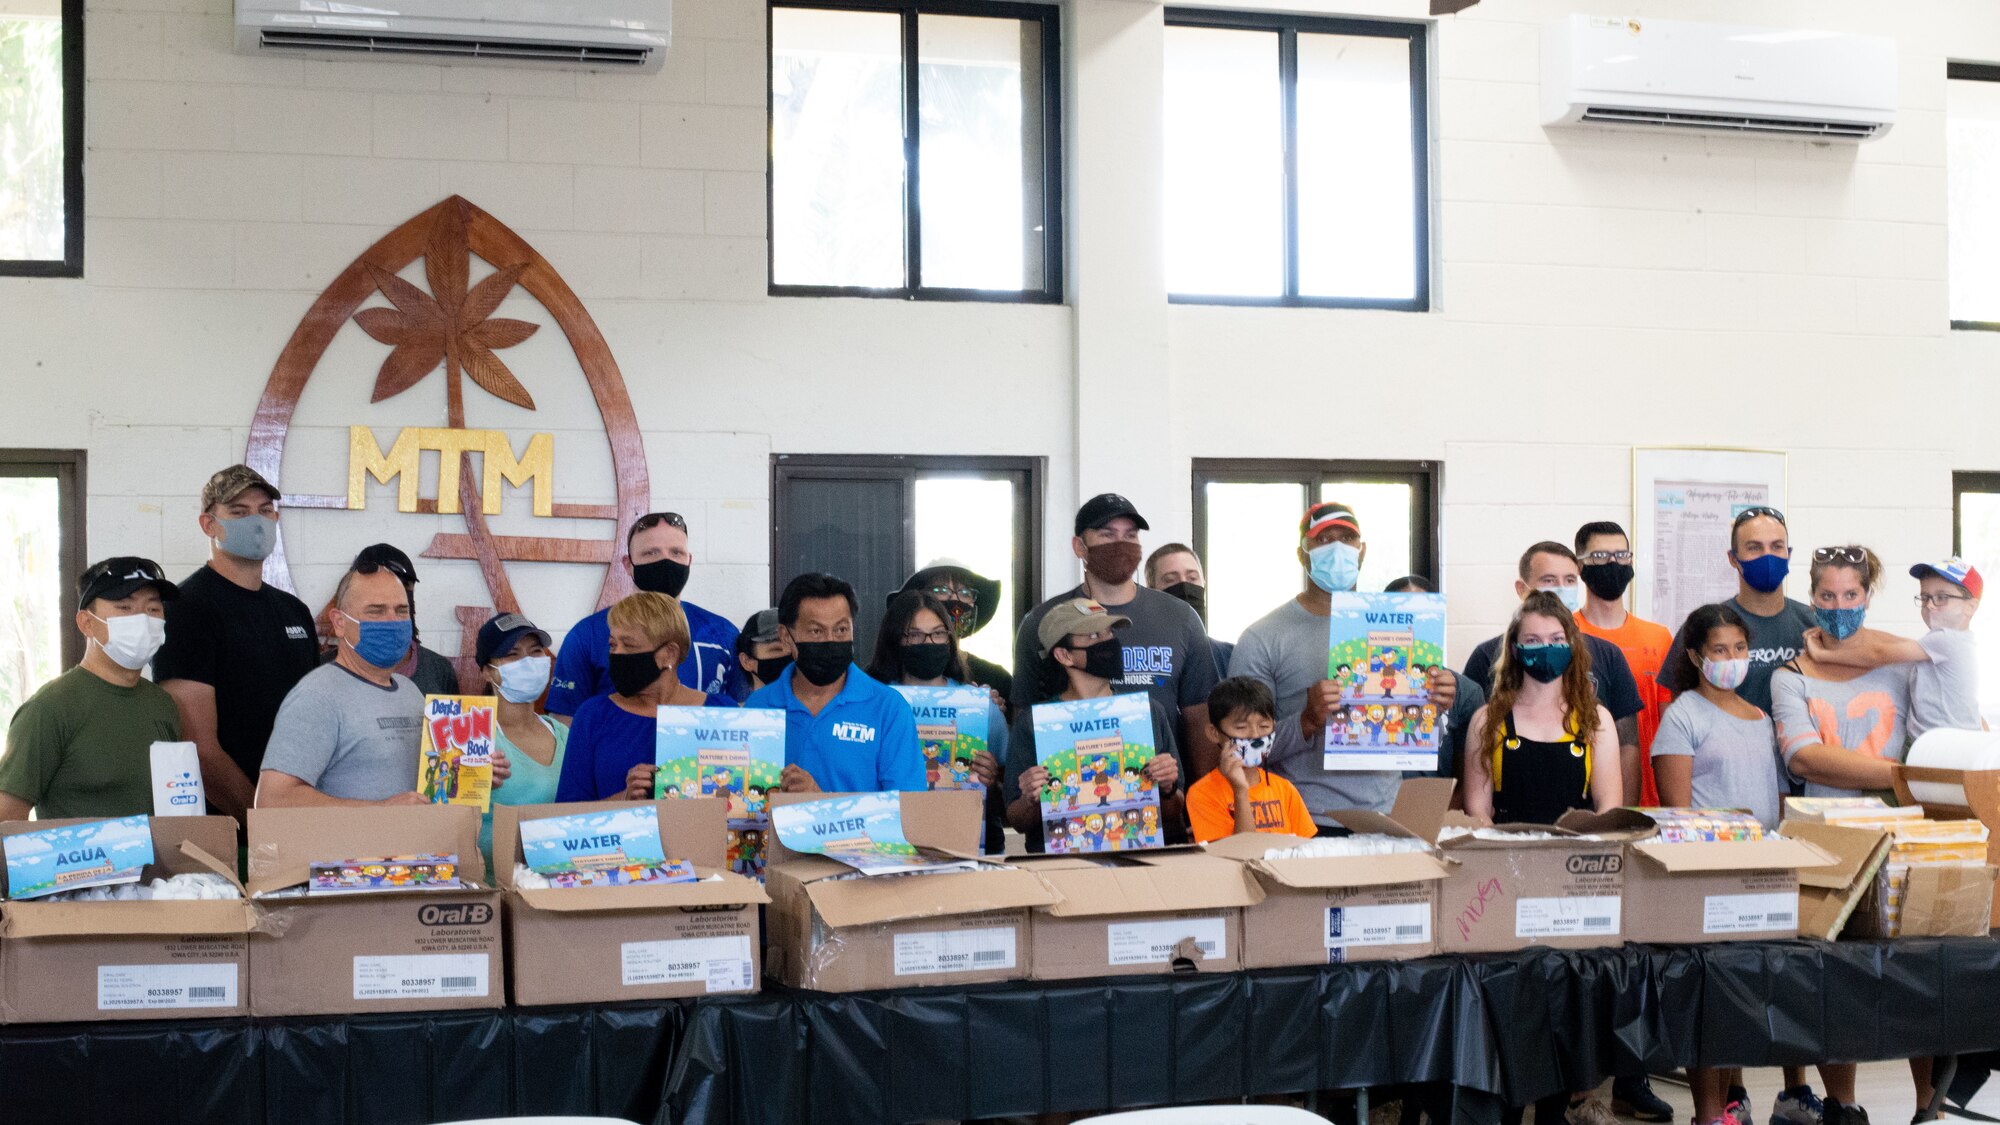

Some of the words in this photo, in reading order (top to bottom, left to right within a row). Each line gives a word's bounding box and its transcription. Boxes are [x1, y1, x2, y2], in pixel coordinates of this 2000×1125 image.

[347, 425, 554, 516] MTM
[1365, 612, 1414, 625] WATER
[1122, 646, 1173, 673] ORCE
[432, 699, 462, 715] Dental
[431, 707, 492, 750] FUN
[832, 723, 876, 741] MTM
[1069, 717, 1120, 734] WATER
[695, 728, 749, 742] WATER
[466, 740, 490, 756] Book
[700, 753, 728, 762] NATURE'S
[165, 780, 198, 788] Crest
[812, 817, 865, 836] WATER
[563, 834, 621, 851] WATER
[56, 847, 107, 866] AGUA
[1568, 856, 1621, 873] Oral-B
[421, 905, 489, 925] Oral-B
[690, 914, 738, 923] Laboratories
[181, 935, 233, 943] Laboratories
[668, 962, 700, 970] 80338957
[147, 988, 183, 996] 80338957
